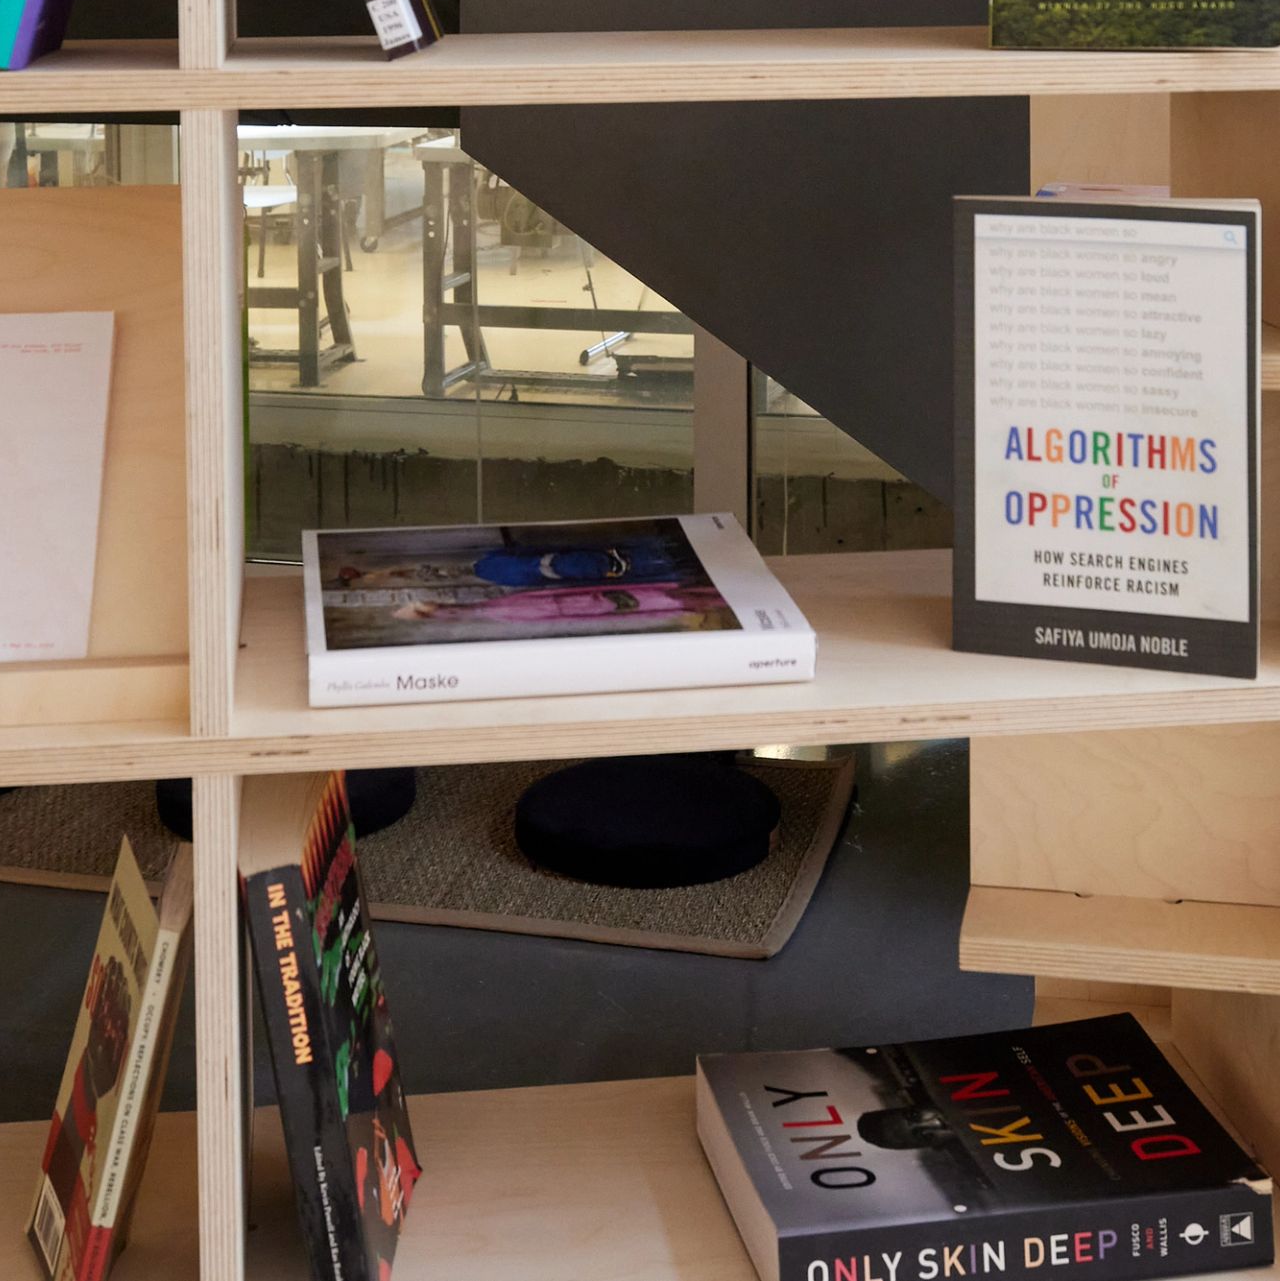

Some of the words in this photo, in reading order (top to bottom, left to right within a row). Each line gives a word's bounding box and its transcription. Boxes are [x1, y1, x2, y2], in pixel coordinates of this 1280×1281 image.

[1005, 426, 1218, 475] ALGORITHMS
[1102, 473, 1120, 490] OF
[1005, 491, 1219, 540] OPPRESSION
[1034, 549, 1065, 567] HOW
[1069, 552, 1124, 571] SEARCH
[1129, 556, 1190, 576] ENGINES
[1043, 573, 1120, 593] REINFORCE
[1126, 577, 1180, 597] RACISM
[1035, 626, 1086, 649] SAFIYA
[1089, 629, 1137, 654] UMOJA
[1140, 633, 1189, 657] NOBLE
[748, 658, 797, 670] aperture
[396, 674, 460, 691] Maske
[266, 883, 287, 909] IN
[269, 911, 293, 948] THE
[277, 949, 313, 1065] TRADITION
[939, 1071, 1062, 1172] SKIN
[1066, 1053, 1202, 1161] DEEP
[764, 1084, 876, 1190] ONLY
[1131, 1223, 1141, 1257] FUSCO
[1145, 1227, 1154, 1249] AND
[1158, 1217, 1169, 1257] WALLIS
[807, 1251, 904, 1281] ONLY
[918, 1241, 1006, 1277] SKIN
[1024, 1230, 1118, 1269] DEEP
